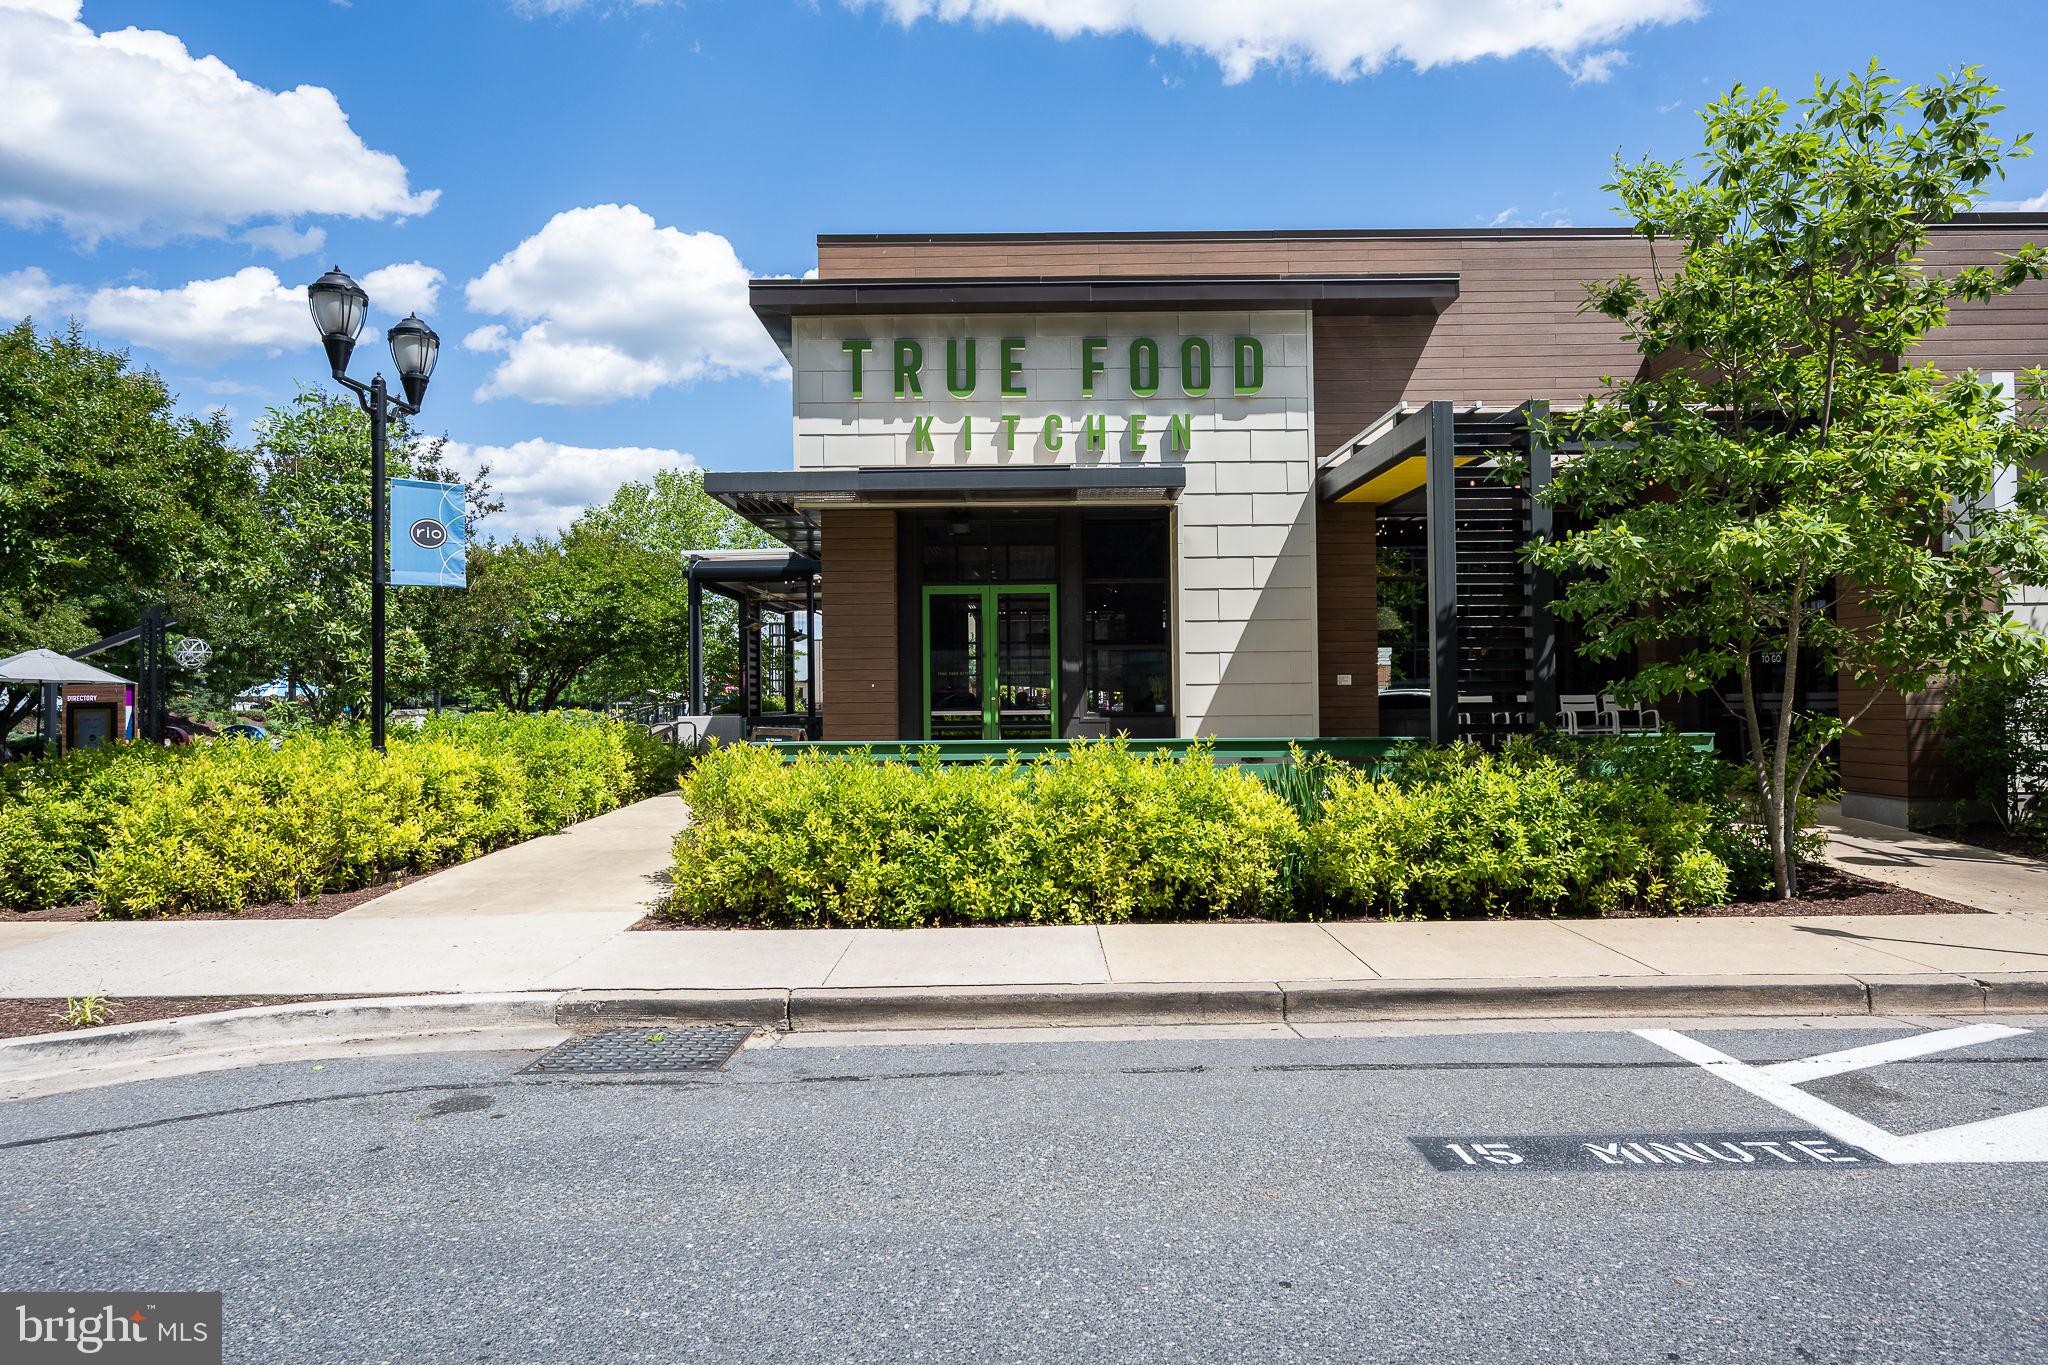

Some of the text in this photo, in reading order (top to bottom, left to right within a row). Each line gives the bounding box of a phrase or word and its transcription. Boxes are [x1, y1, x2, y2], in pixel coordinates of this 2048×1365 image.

[842, 336, 1264, 400] TRUE FOOD
[914, 413, 1192, 453] KITCHEN
[416, 526, 442, 539] rio
[1771, 654, 1782, 663] GO
[67, 694, 98, 702] DIRECTORY
[1445, 1139, 1861, 1166] 15 MINUTE
